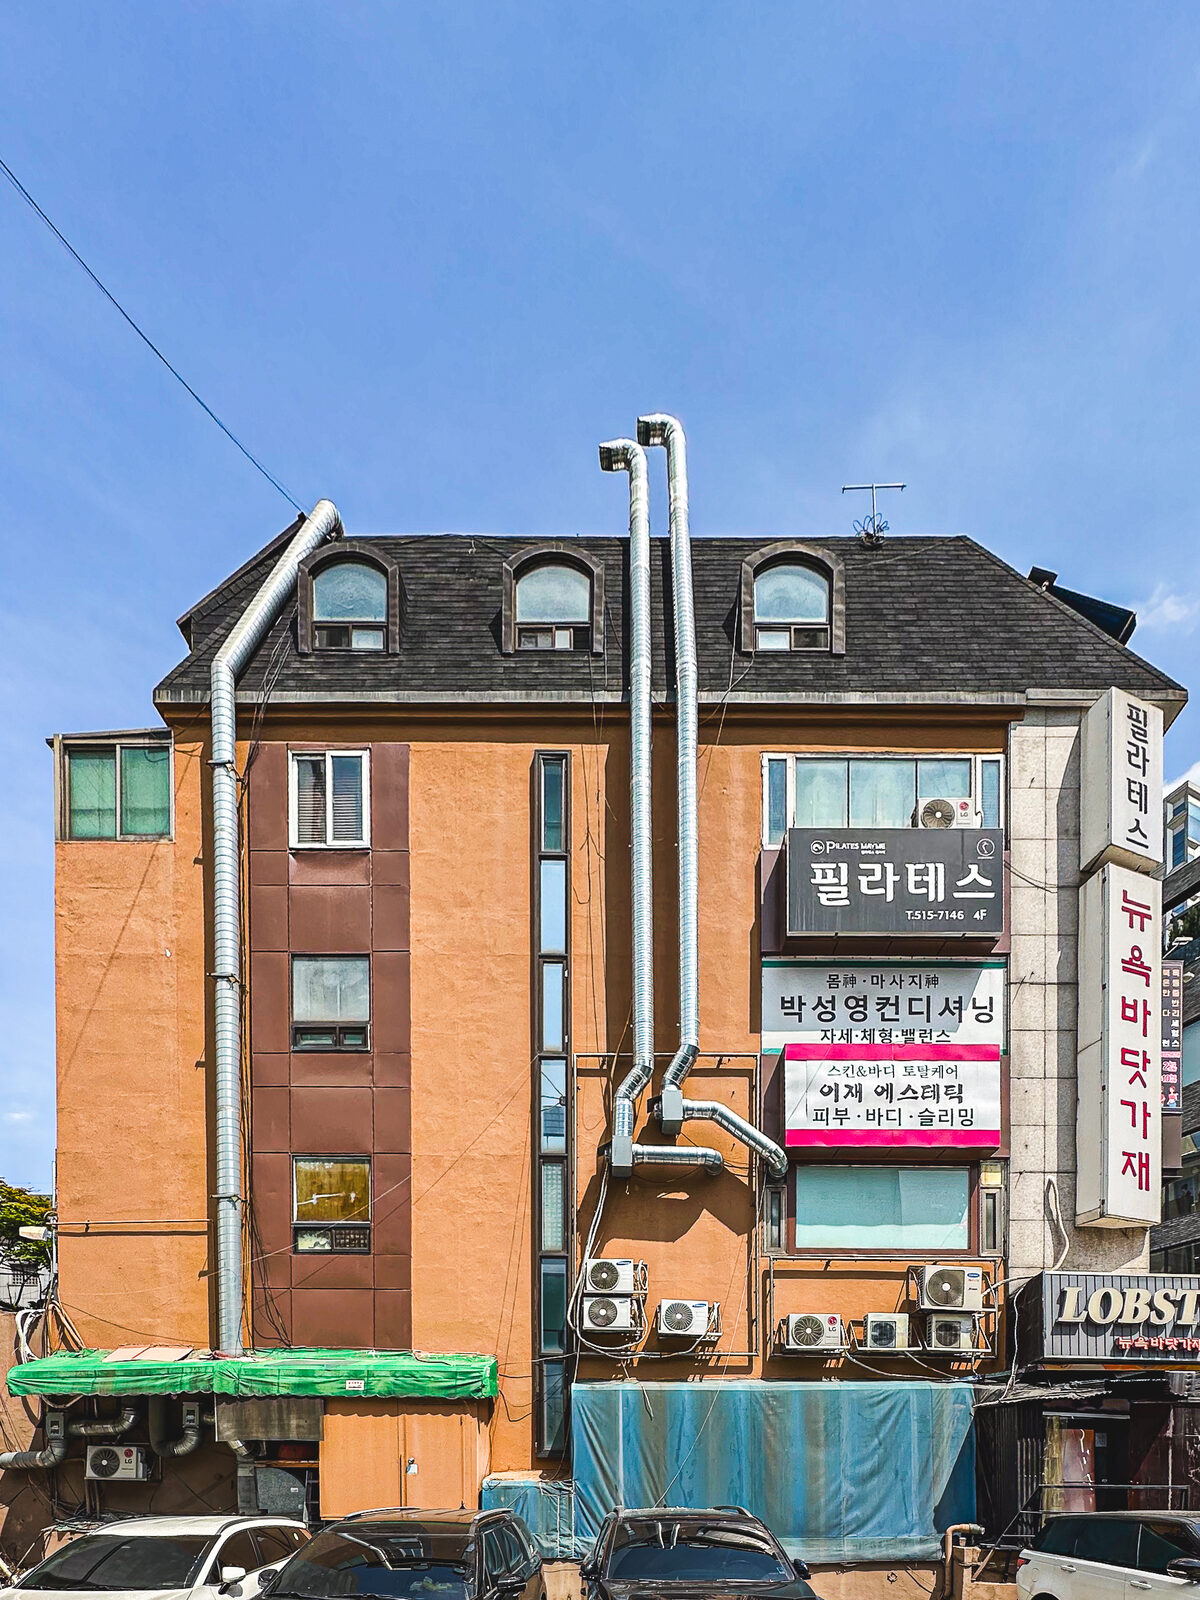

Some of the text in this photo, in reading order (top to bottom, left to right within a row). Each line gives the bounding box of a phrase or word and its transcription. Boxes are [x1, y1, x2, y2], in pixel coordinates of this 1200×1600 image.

[1125, 702, 1150, 850] 필라테스
[810, 862, 996, 906] 필라테스
[905, 909, 987, 920] T.515-7146 4F
[780, 994, 994, 1024] 박성영컨디셔닝
[1120, 889, 1152, 1192] 뉴욕바닷가재
[827, 1064, 895, 1079] 스킨&바디
[819, 1082, 964, 1104] 이재 에스테틱
[1056, 1286, 1200, 1325] LOBST
